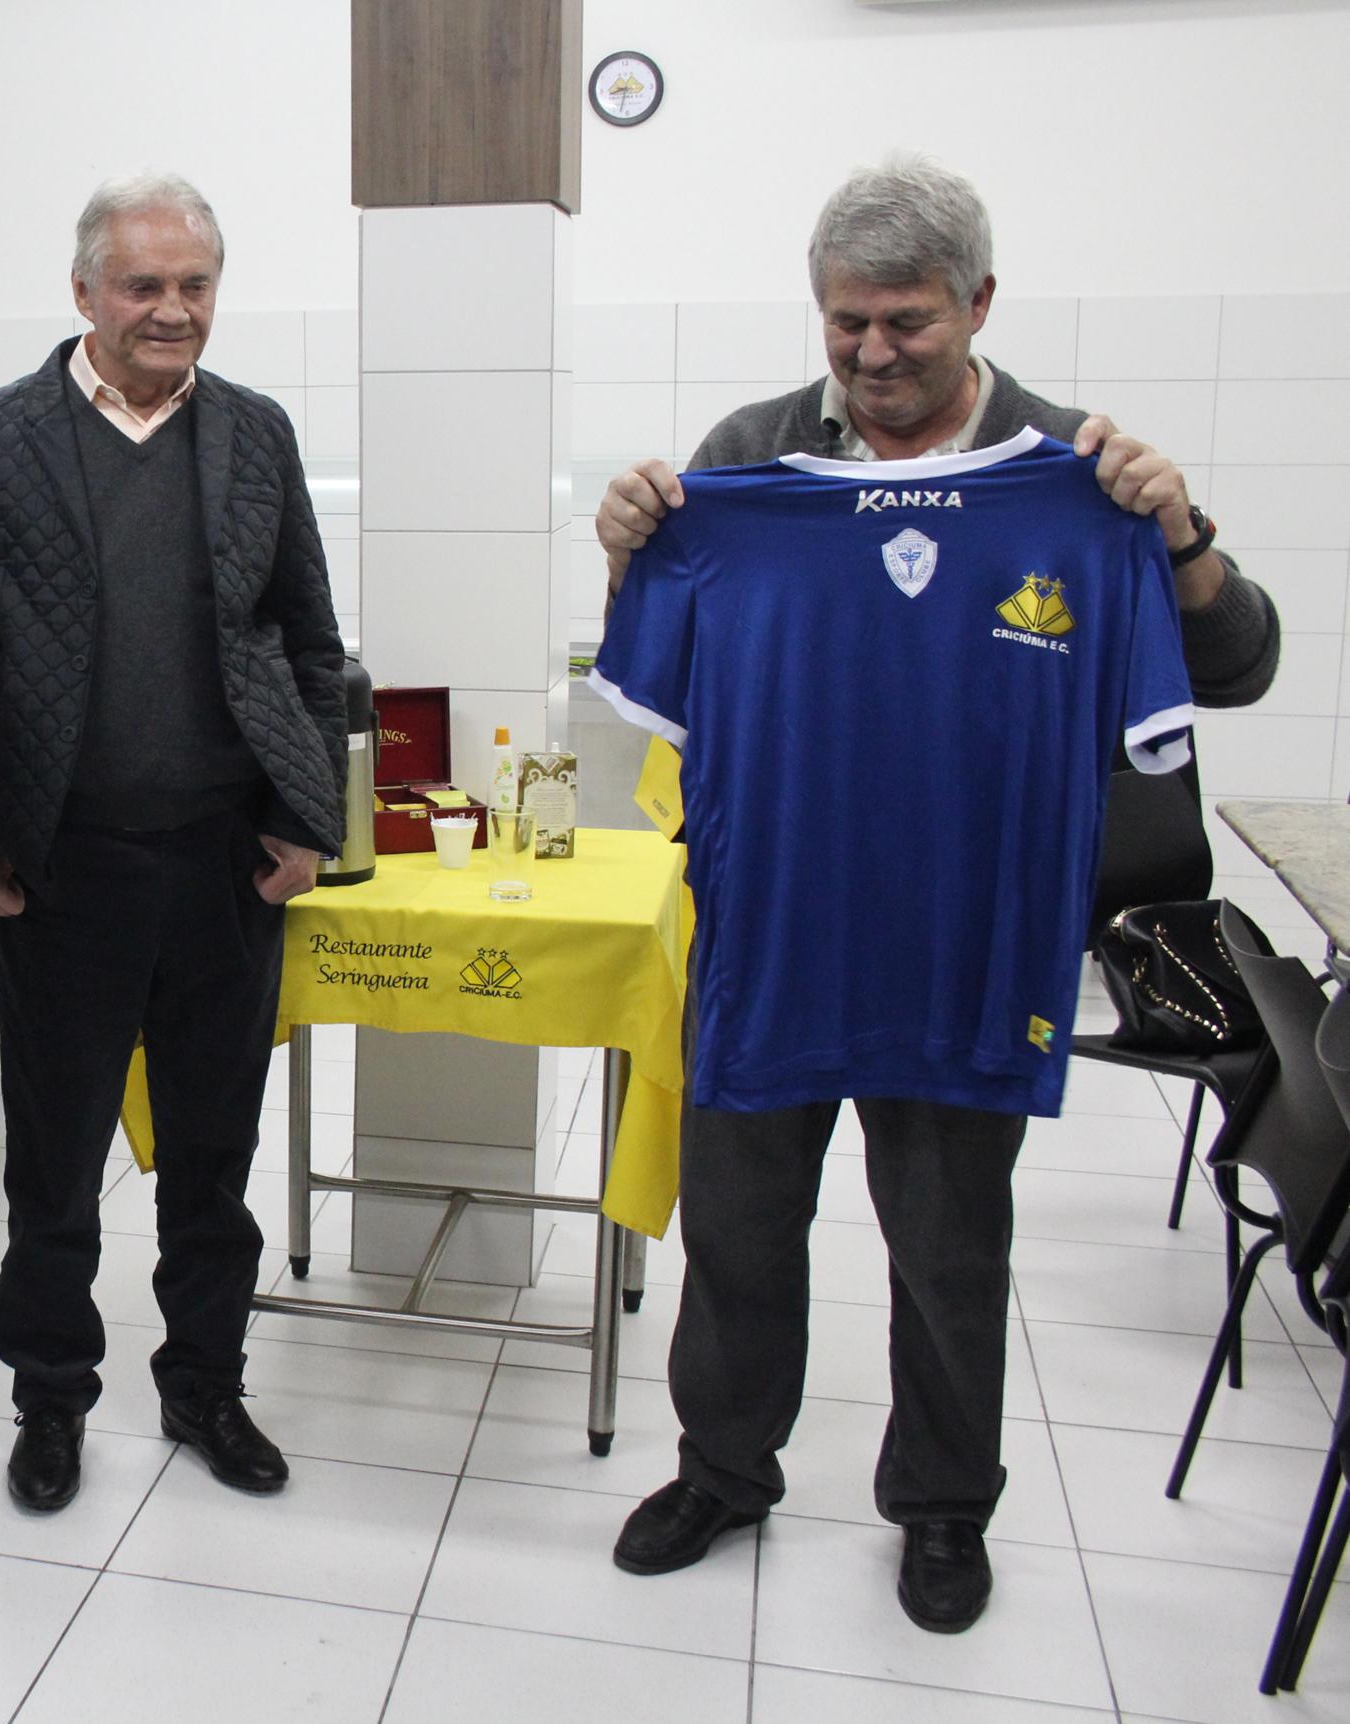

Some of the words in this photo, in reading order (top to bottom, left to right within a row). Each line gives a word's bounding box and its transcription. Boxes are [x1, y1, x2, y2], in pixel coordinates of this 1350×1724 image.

[854, 488, 963, 514] KANXA
[991, 627, 1048, 649] CRICIÚMA
[309, 933, 433, 960] Restaurante
[316, 963, 430, 993] Seringueira
